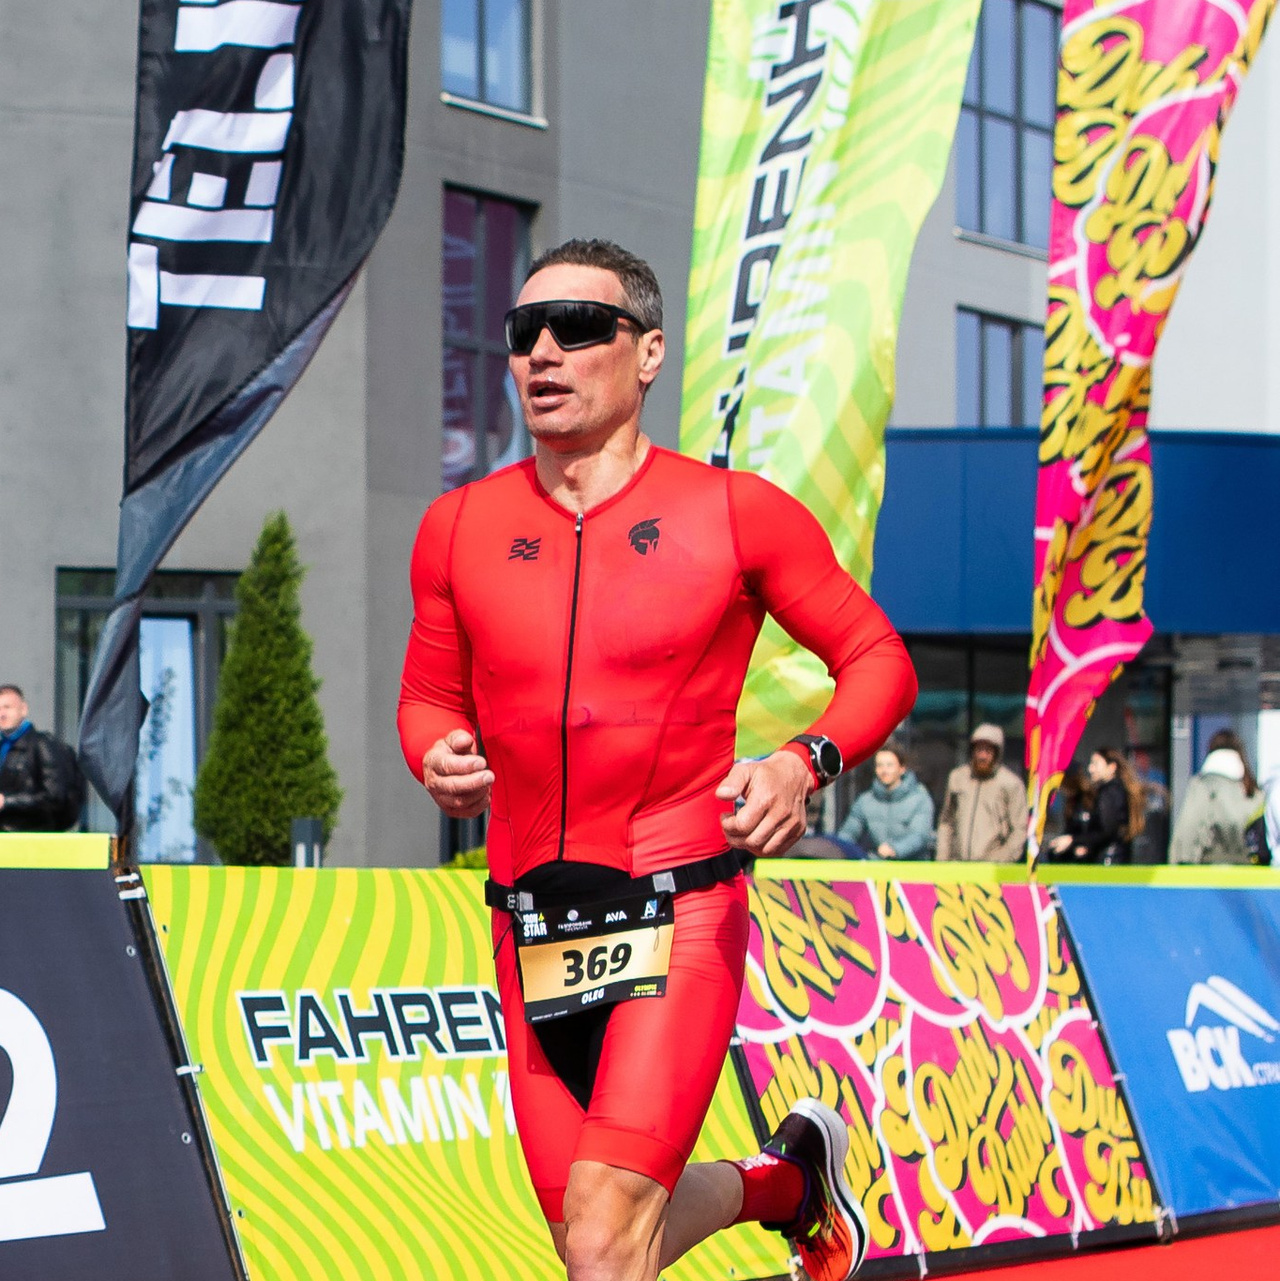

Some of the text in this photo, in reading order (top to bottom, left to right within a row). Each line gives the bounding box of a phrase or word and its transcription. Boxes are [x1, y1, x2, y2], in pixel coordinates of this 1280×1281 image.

[605, 910, 628, 923] AVA
[523, 923, 547, 937] STAR
[562, 942, 632, 987] 369
[581, 987, 605, 1005] OLEG
[262, 1072, 492, 1153] VITAMIN
